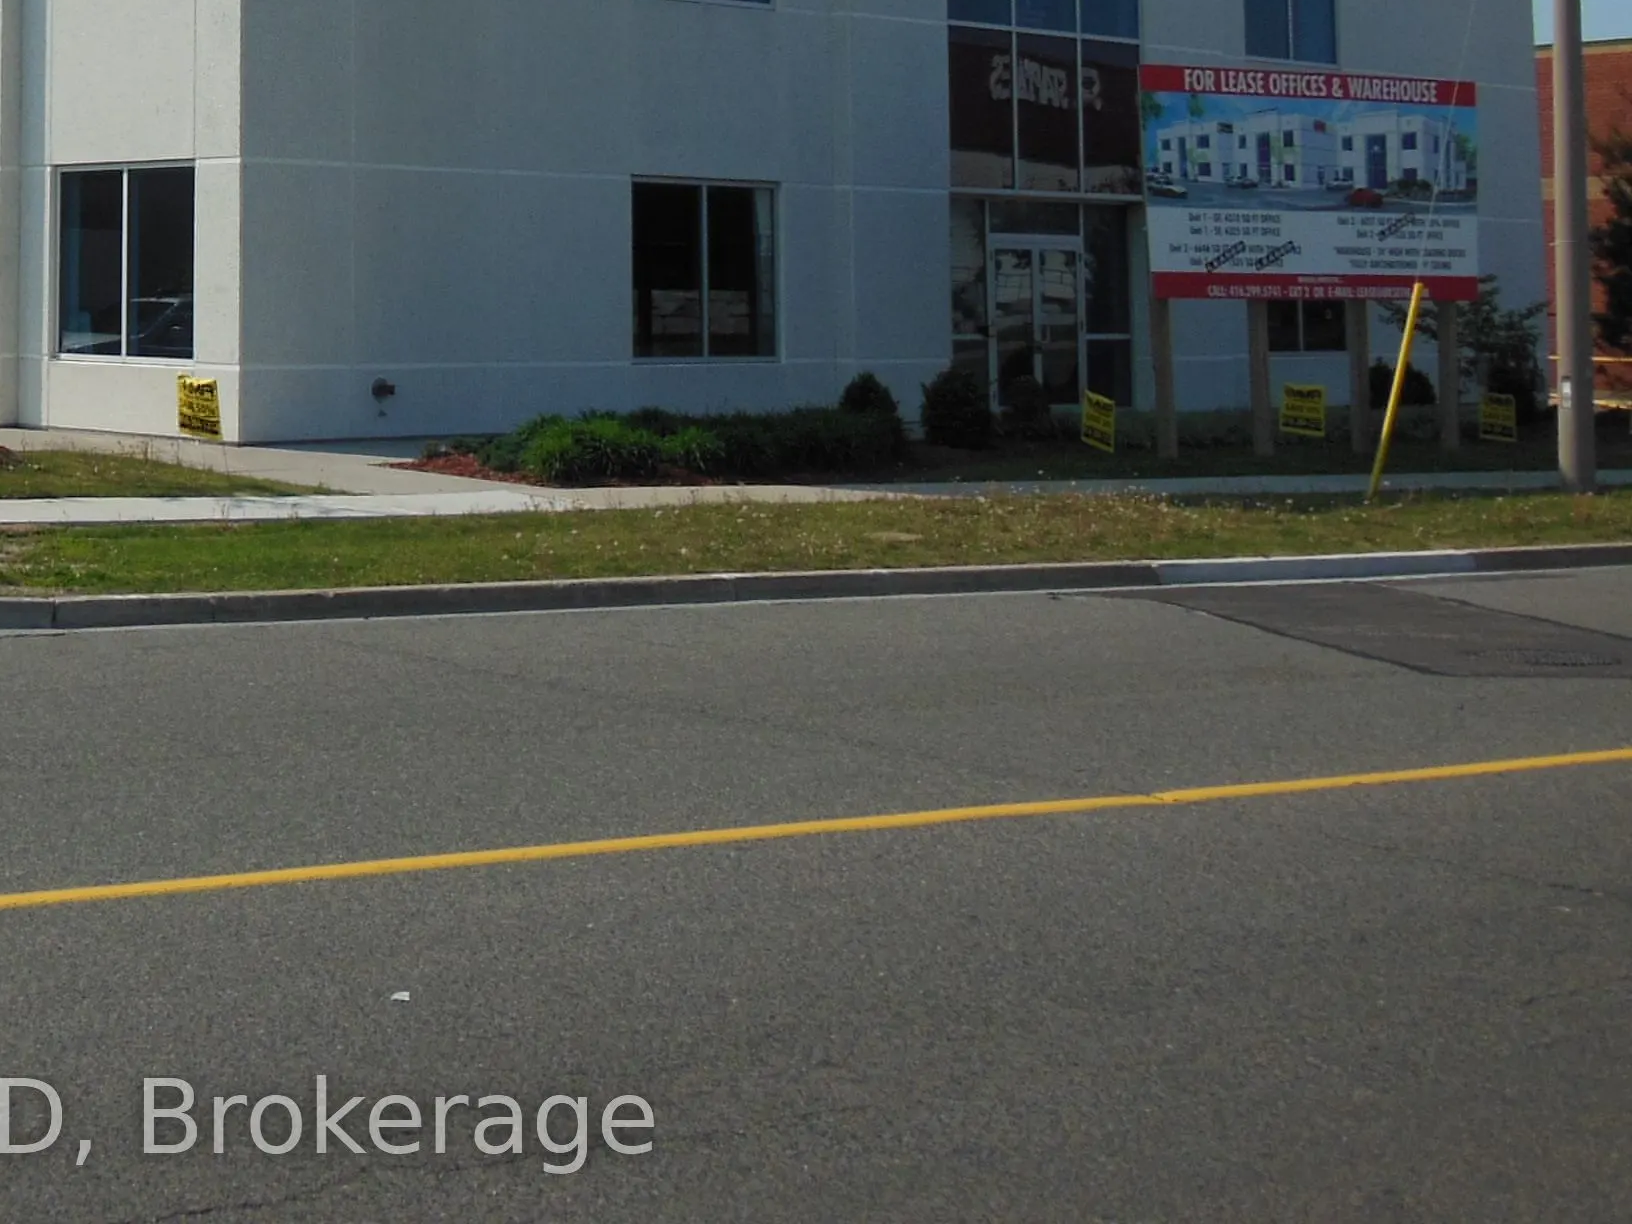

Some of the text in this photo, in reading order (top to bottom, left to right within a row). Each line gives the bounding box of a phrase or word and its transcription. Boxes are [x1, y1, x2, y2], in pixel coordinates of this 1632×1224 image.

[1184, 69, 1438, 103] FOR LEASE OFFICES & WAREHOUSE
